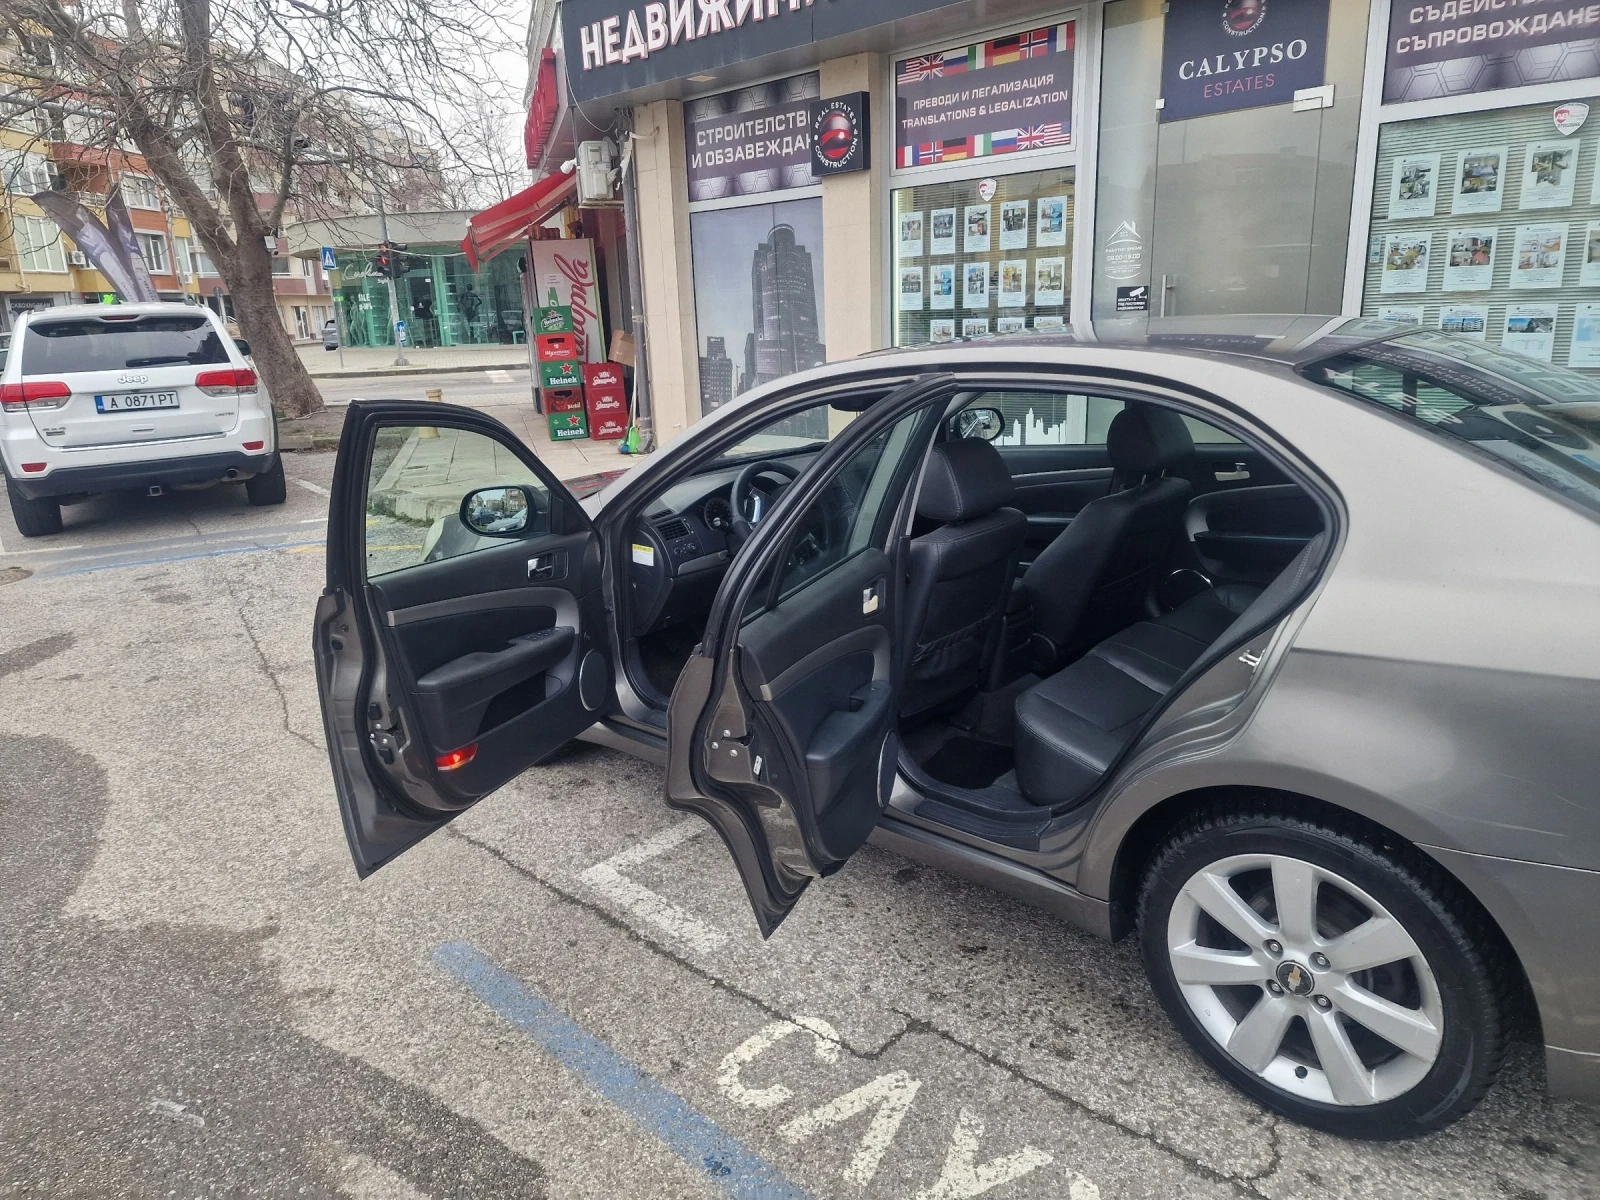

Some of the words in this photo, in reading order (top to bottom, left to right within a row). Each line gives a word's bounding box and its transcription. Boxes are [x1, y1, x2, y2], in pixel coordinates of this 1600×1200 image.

[1178, 39, 1308, 80] CALYPSO
[913, 92, 960, 110] ПРЕВОДИ
[961, 90, 970, 101] И
[971, 73, 1054, 98] ЛЕГАЛИЗАЦИЯ
[1203, 73, 1275, 98] ESTATES
[815, 107, 829, 129] REAL
[830, 101, 857, 125] ESTATES
[902, 107, 977, 129] TRANSLATIONS
[978, 106, 987, 116] &
[988, 90, 1068, 114] LEGALIZATION
[696, 110, 811, 146] СТРОИТЕЛСТВ
[691, 153, 702, 169] И
[815, 137, 858, 168] CONSTRUCTION
[118, 374, 149, 384] Jeep
